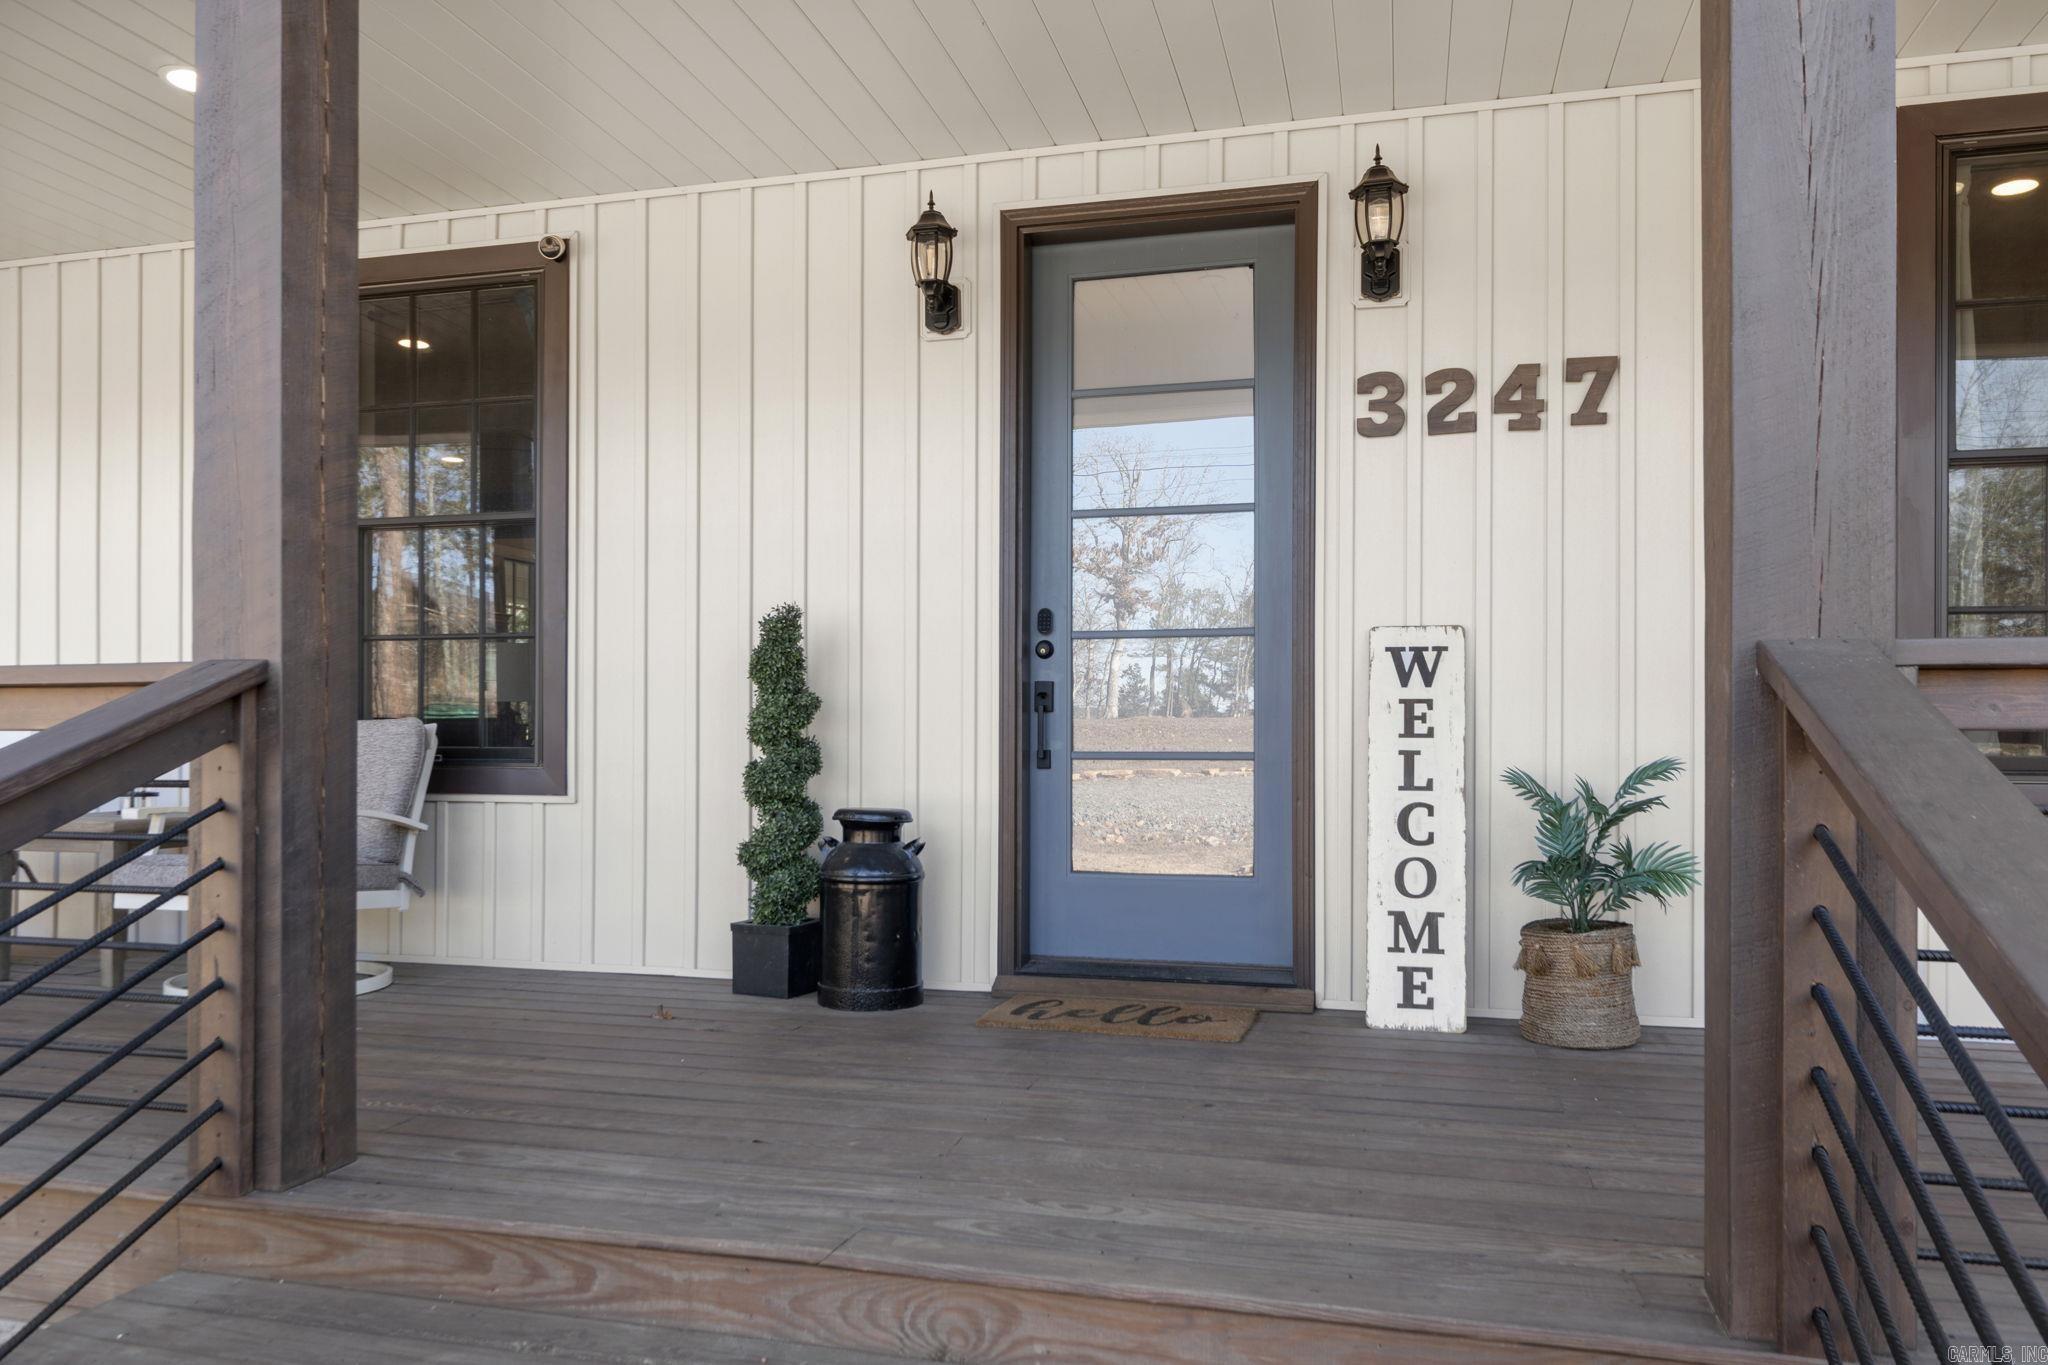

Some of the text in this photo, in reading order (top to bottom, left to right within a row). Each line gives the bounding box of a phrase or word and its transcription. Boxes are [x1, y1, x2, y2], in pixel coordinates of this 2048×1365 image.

[1356, 356, 1620, 438] 3247
[1385, 645, 1449, 1010] WELCOME
[1010, 999, 1227, 1026] hello
